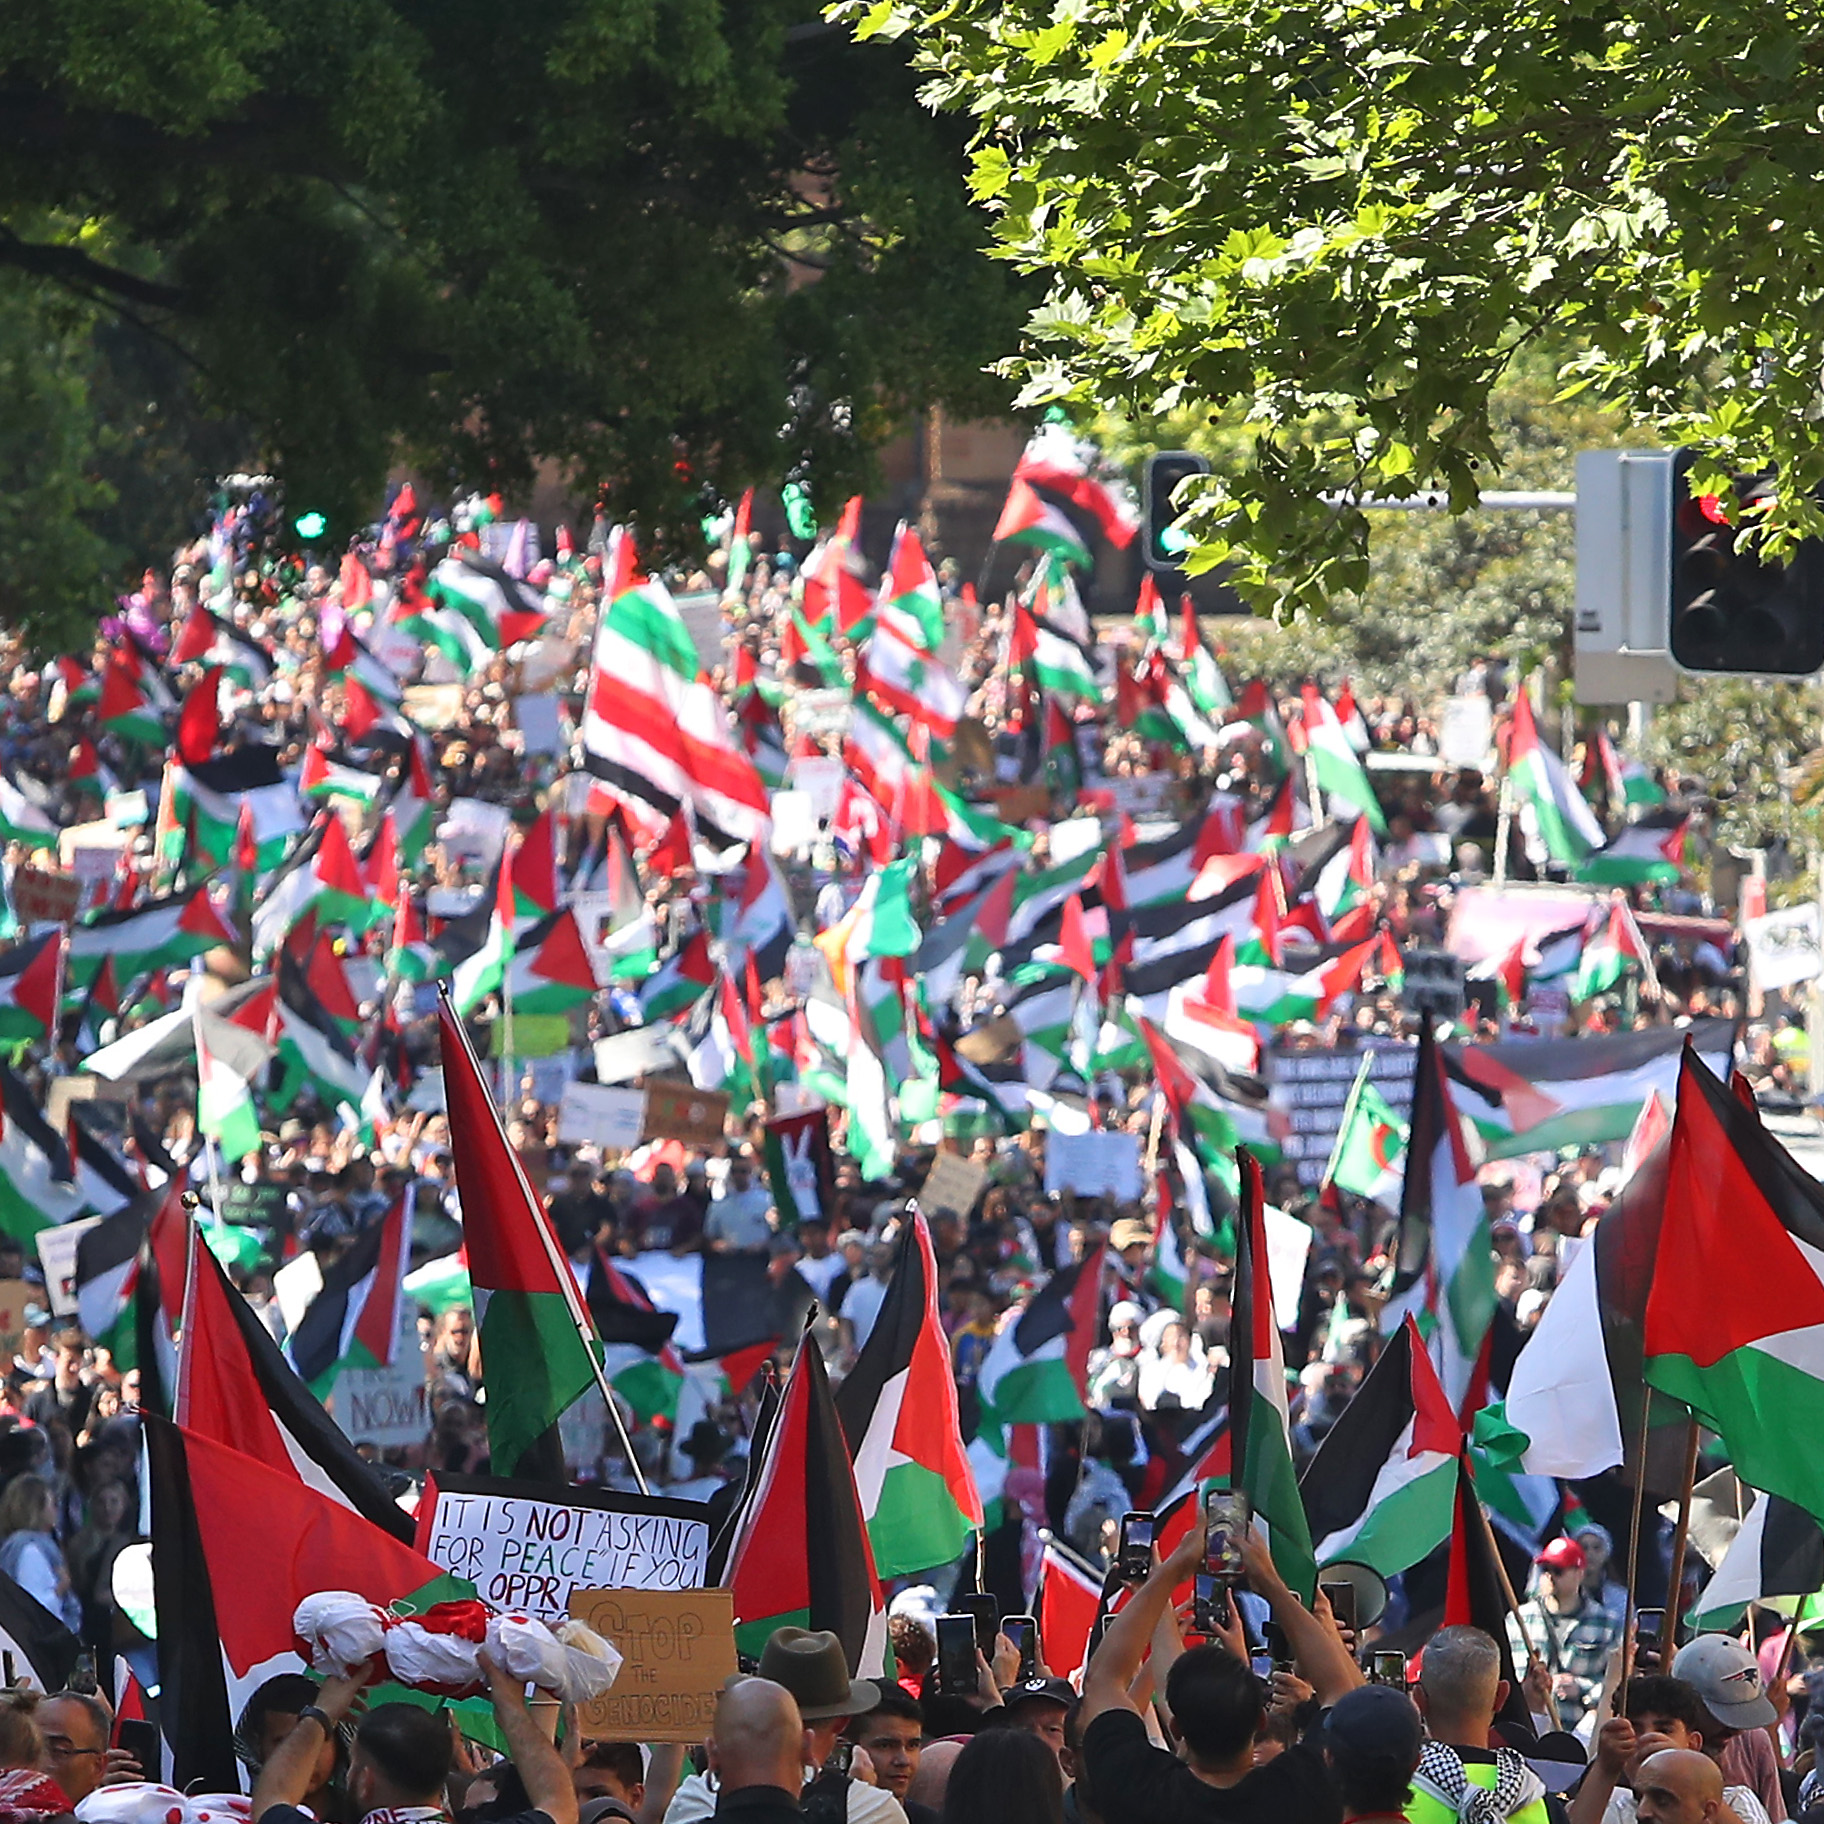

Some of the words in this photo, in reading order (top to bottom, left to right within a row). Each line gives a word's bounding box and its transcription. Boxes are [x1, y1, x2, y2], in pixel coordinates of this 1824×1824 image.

[441, 1500, 475, 1527] IT
[482, 1501, 515, 1534] IS
[526, 1506, 591, 1545] NOT
[433, 1534, 484, 1567] FOR
[610, 1551, 641, 1582] IF
[641, 1557, 699, 1589] YOU
[588, 1600, 704, 1661] STOP
[631, 1664, 657, 1684] THE
